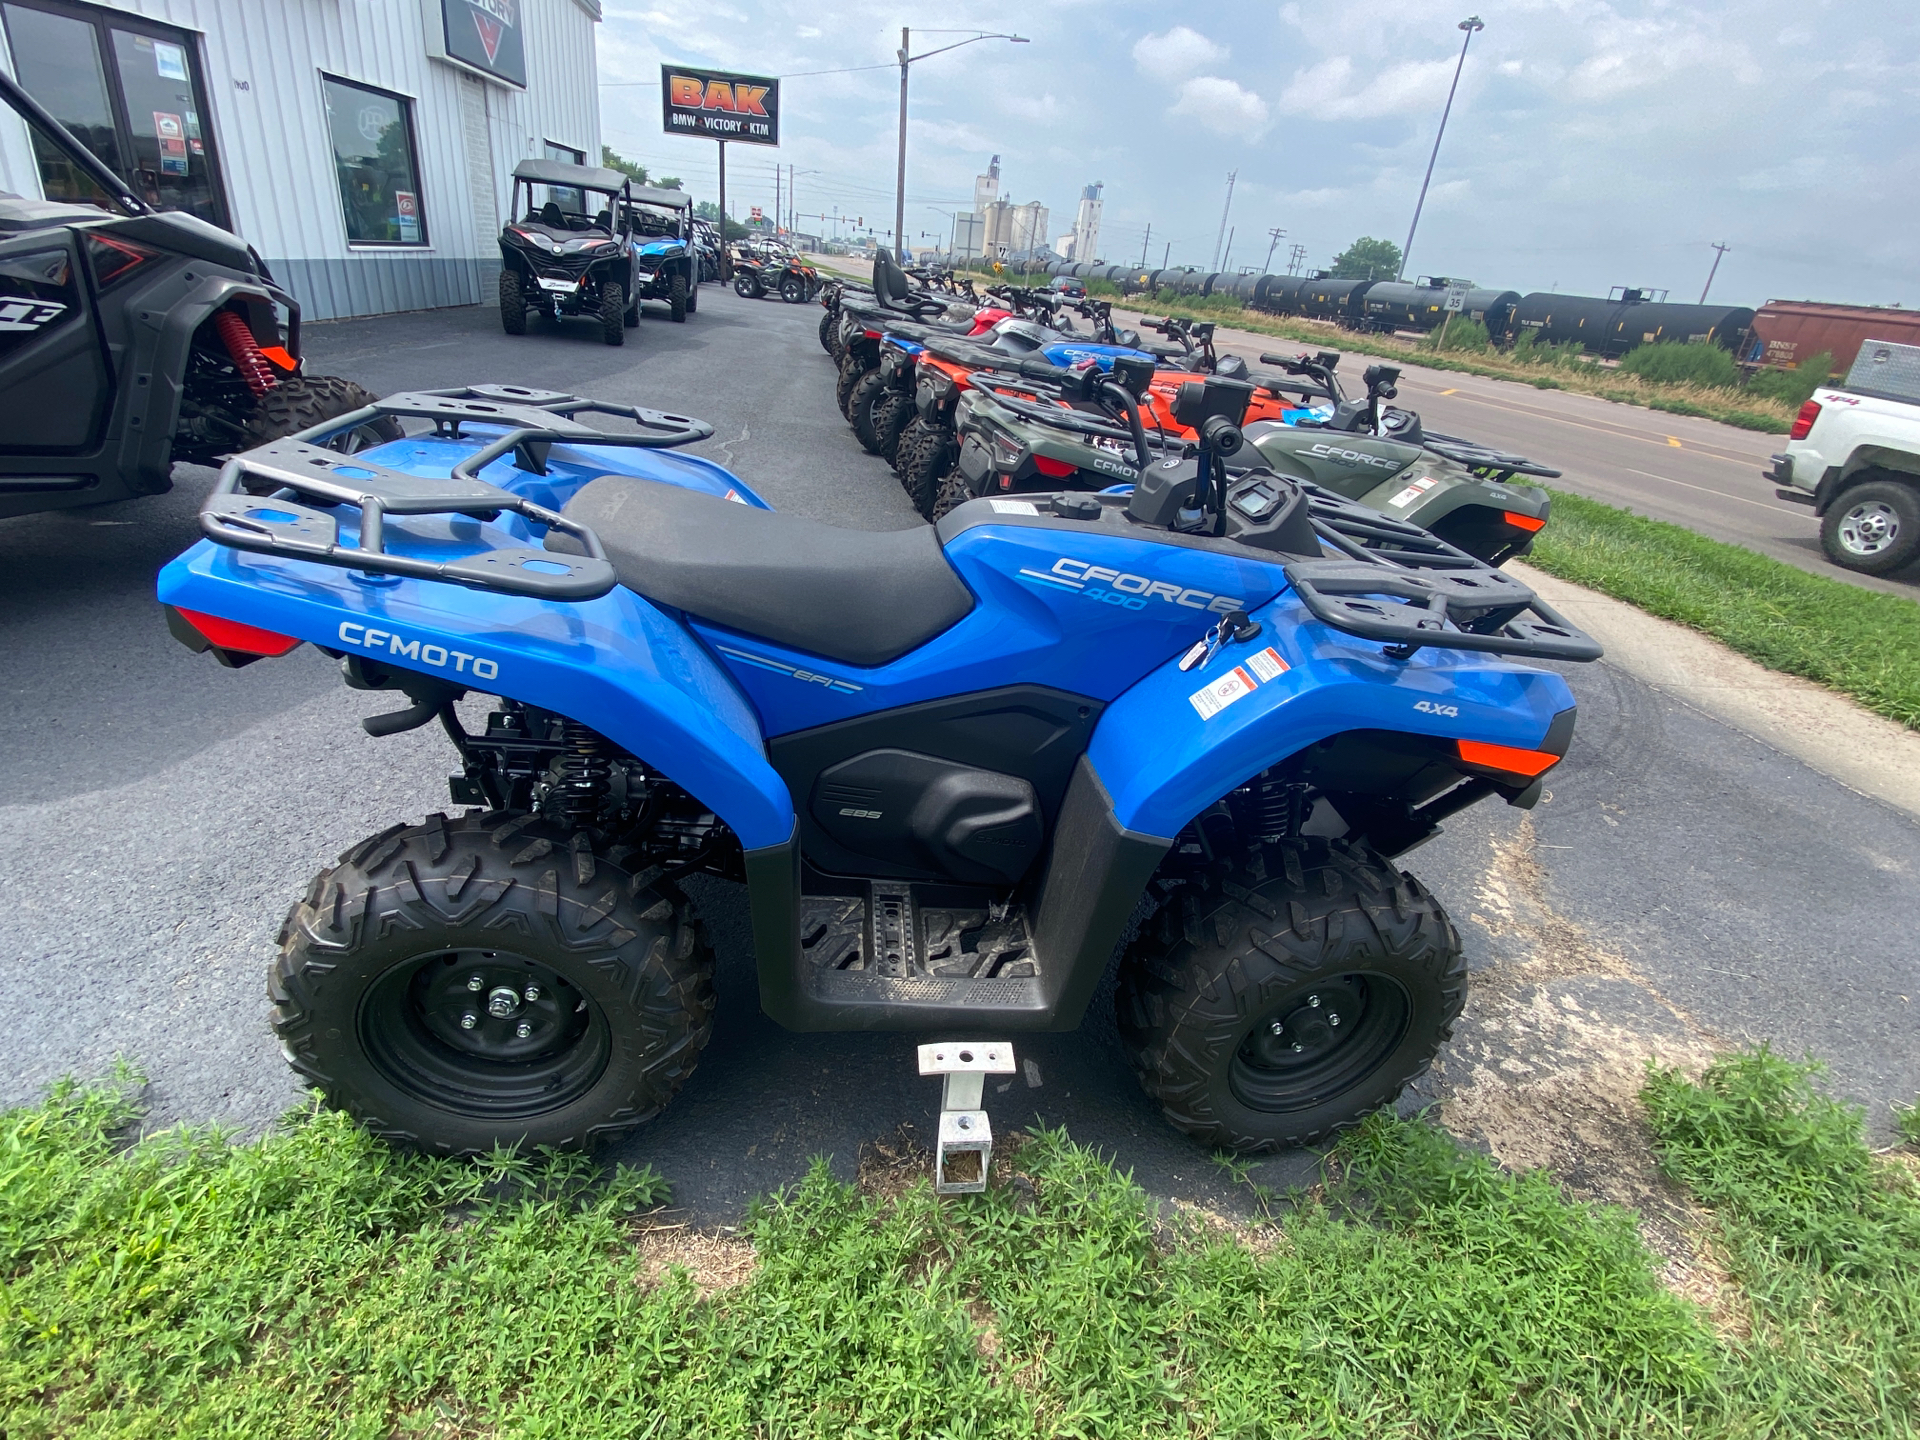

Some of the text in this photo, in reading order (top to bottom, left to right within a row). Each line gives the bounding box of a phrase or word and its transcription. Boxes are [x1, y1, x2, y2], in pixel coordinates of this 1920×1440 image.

[670, 75, 770, 117] BAK
[672, 113, 769, 135] BMW VICTORY KTM
[1451, 289, 1466, 297] LIMIT
[1452, 282, 1471, 290] SPEED
[1449, 298, 1461, 308] 35
[1768, 340, 1798, 351] BNSF
[1311, 443, 1402, 471] CFORCE
[1326, 457, 1358, 469] 400
[1051, 557, 1245, 616] CFORCE
[1082, 587, 1148, 611] 400
[338, 621, 499, 680] CFMOTO
[793, 669, 834, 688] EFI
[838, 808, 883, 820] EBS
